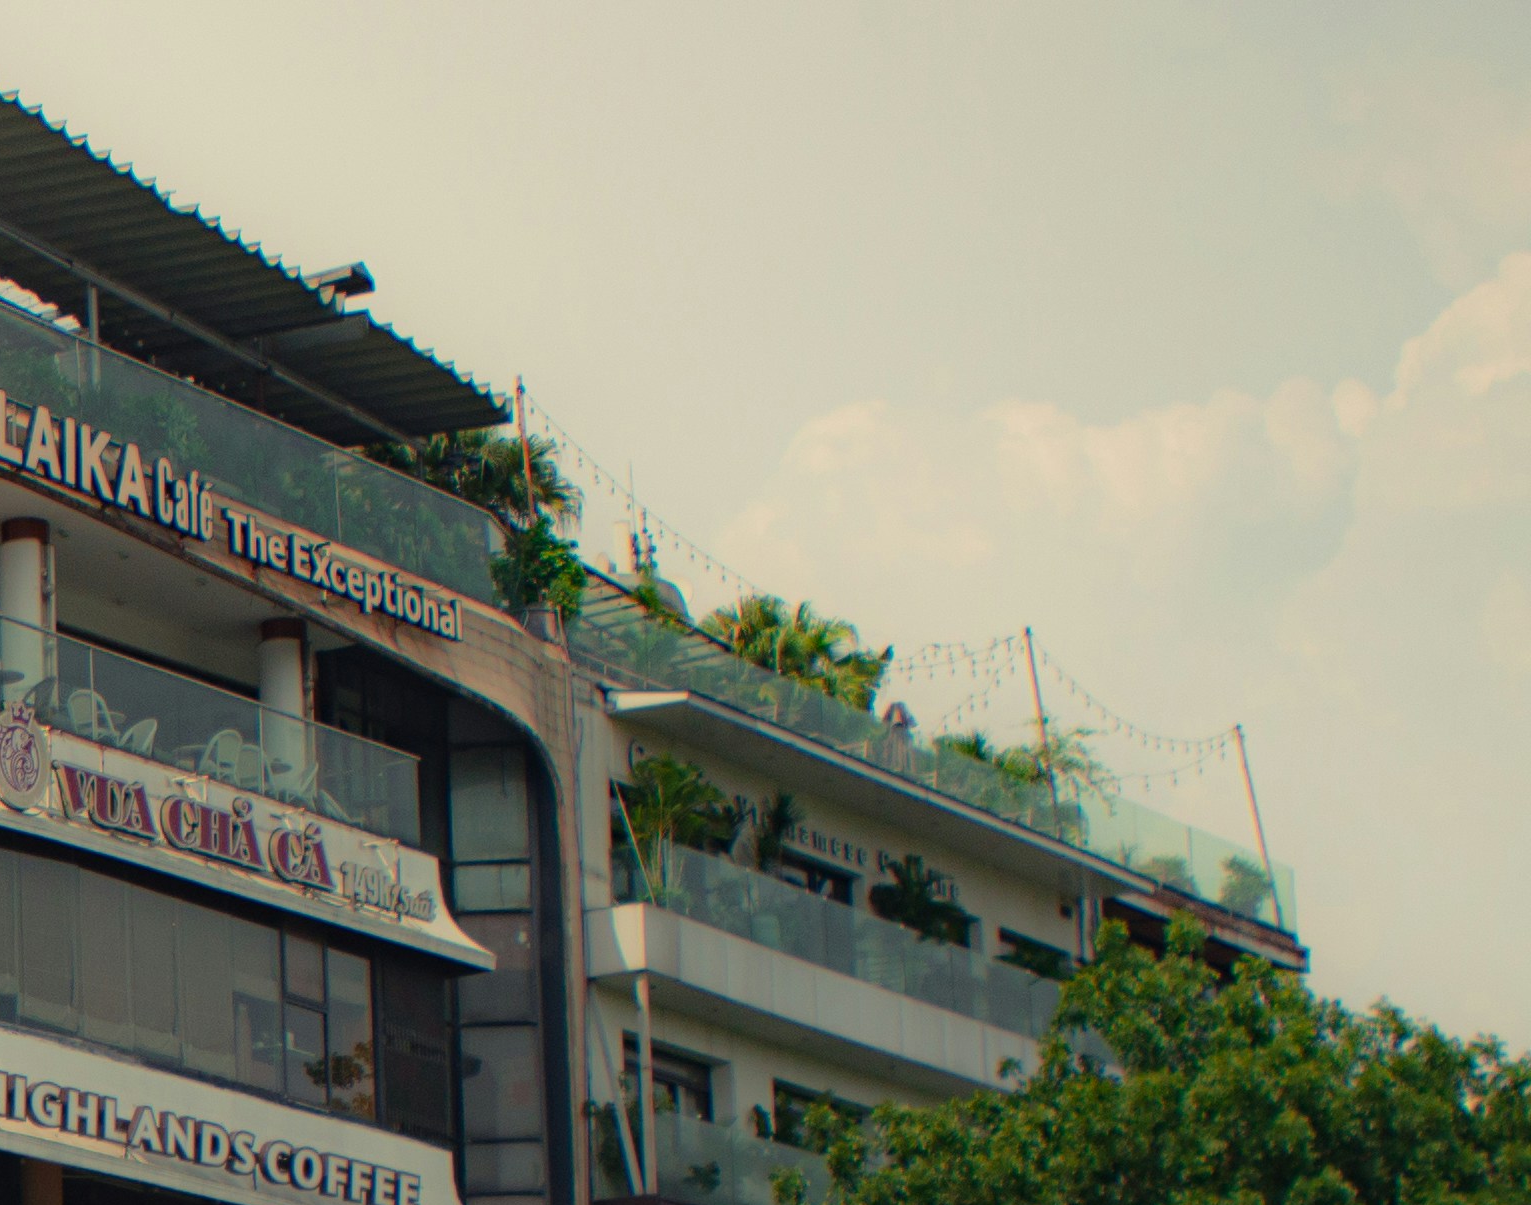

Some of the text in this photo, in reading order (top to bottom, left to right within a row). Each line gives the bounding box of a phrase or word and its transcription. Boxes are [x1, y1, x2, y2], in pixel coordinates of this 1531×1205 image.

[151, 457, 217, 543] Café
[224, 506, 289, 572] The
[289, 534, 464, 643] Exceptional
[52, 760, 160, 842] VUA
[160, 800, 266, 872] CHẢ
[269, 822, 336, 892] CÁ
